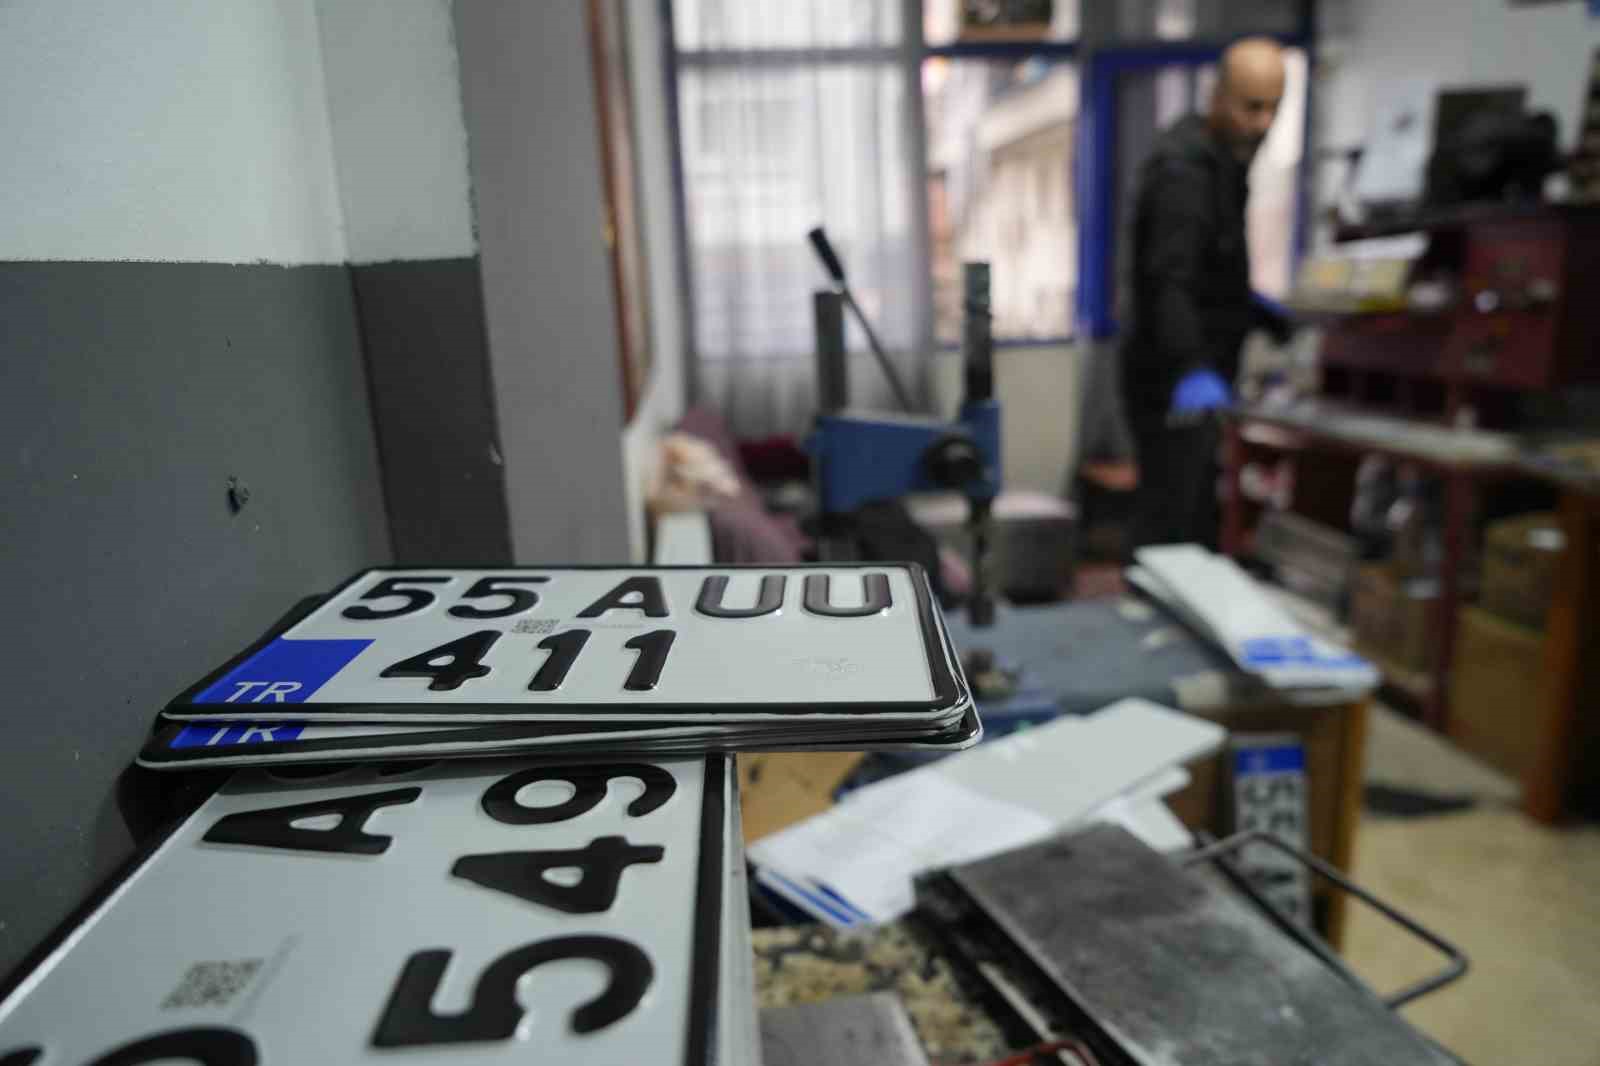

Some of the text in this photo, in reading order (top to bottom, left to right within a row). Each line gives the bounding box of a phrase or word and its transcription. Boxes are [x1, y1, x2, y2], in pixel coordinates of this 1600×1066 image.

[341, 574, 894, 620] 55 AUU
[379, 630, 676, 692] 411
[224, 680, 303, 704] TR
[370, 762, 678, 1050] 549
